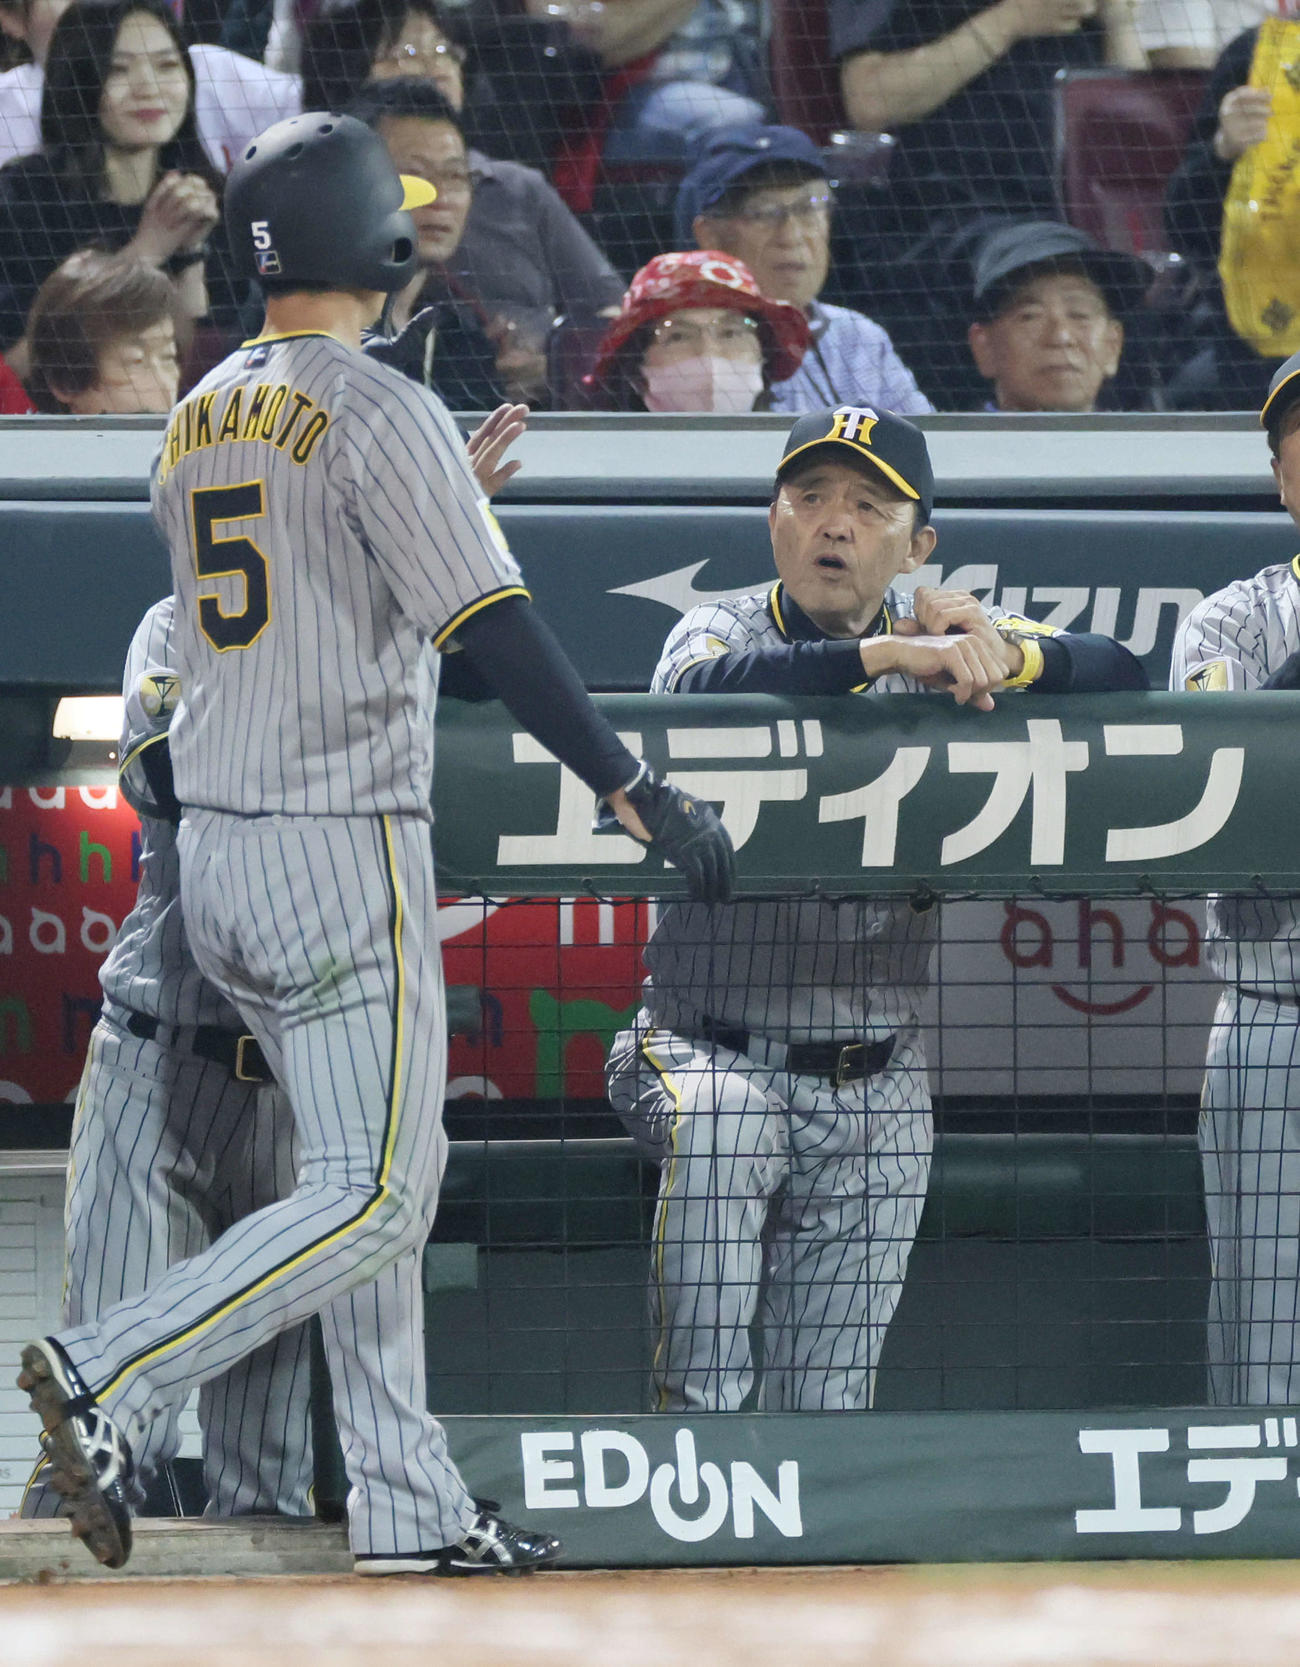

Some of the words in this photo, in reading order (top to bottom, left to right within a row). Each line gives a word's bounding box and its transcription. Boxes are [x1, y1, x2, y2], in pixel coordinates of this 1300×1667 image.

[251, 221, 271, 250] 5
[190, 479, 272, 653] 5
[496, 718, 1246, 869] エディオン
[1074, 1417, 1300, 1535] エデ
